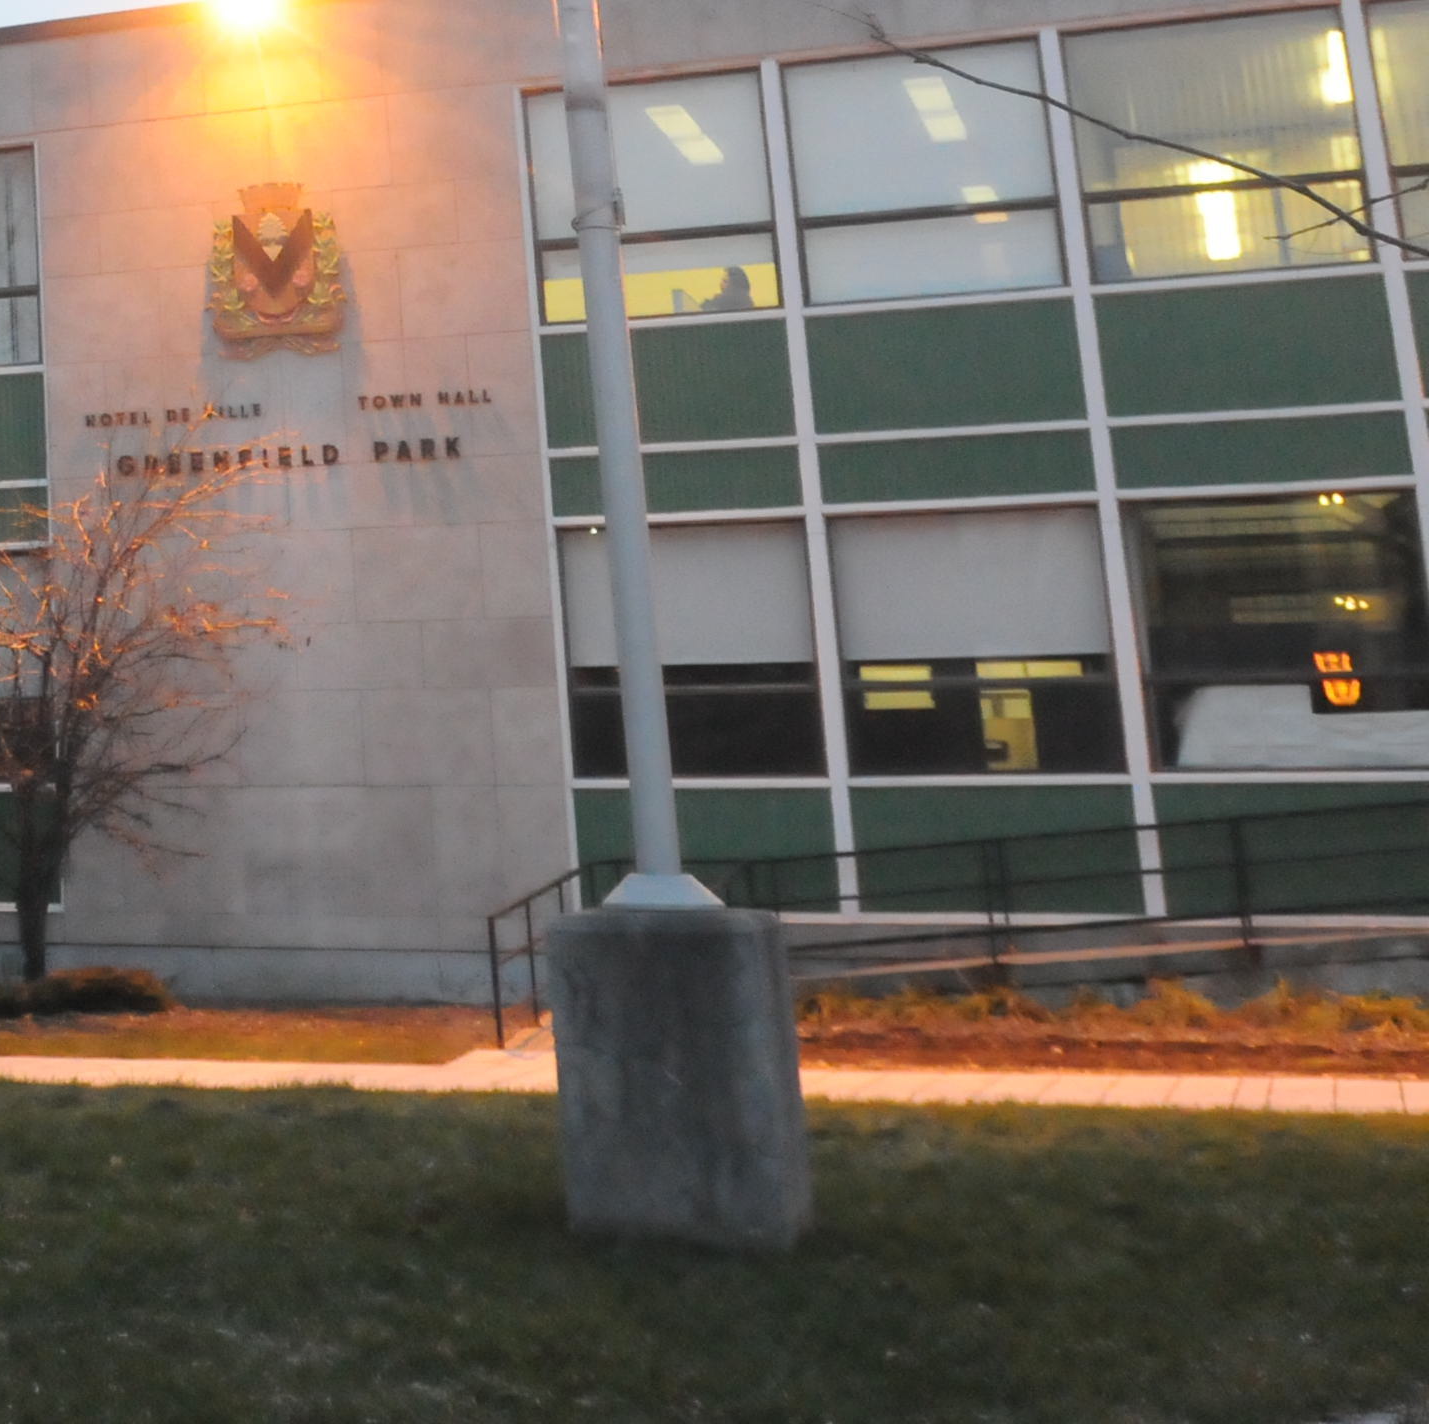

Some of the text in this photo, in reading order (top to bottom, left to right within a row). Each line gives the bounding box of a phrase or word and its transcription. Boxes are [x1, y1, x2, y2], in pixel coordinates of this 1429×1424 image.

[358, 389, 492, 410] TOWN HALL
[85, 411, 151, 427] HOTEL
[166, 407, 190, 423] DE
[117, 436, 461, 475] GREENFIELD PARK
